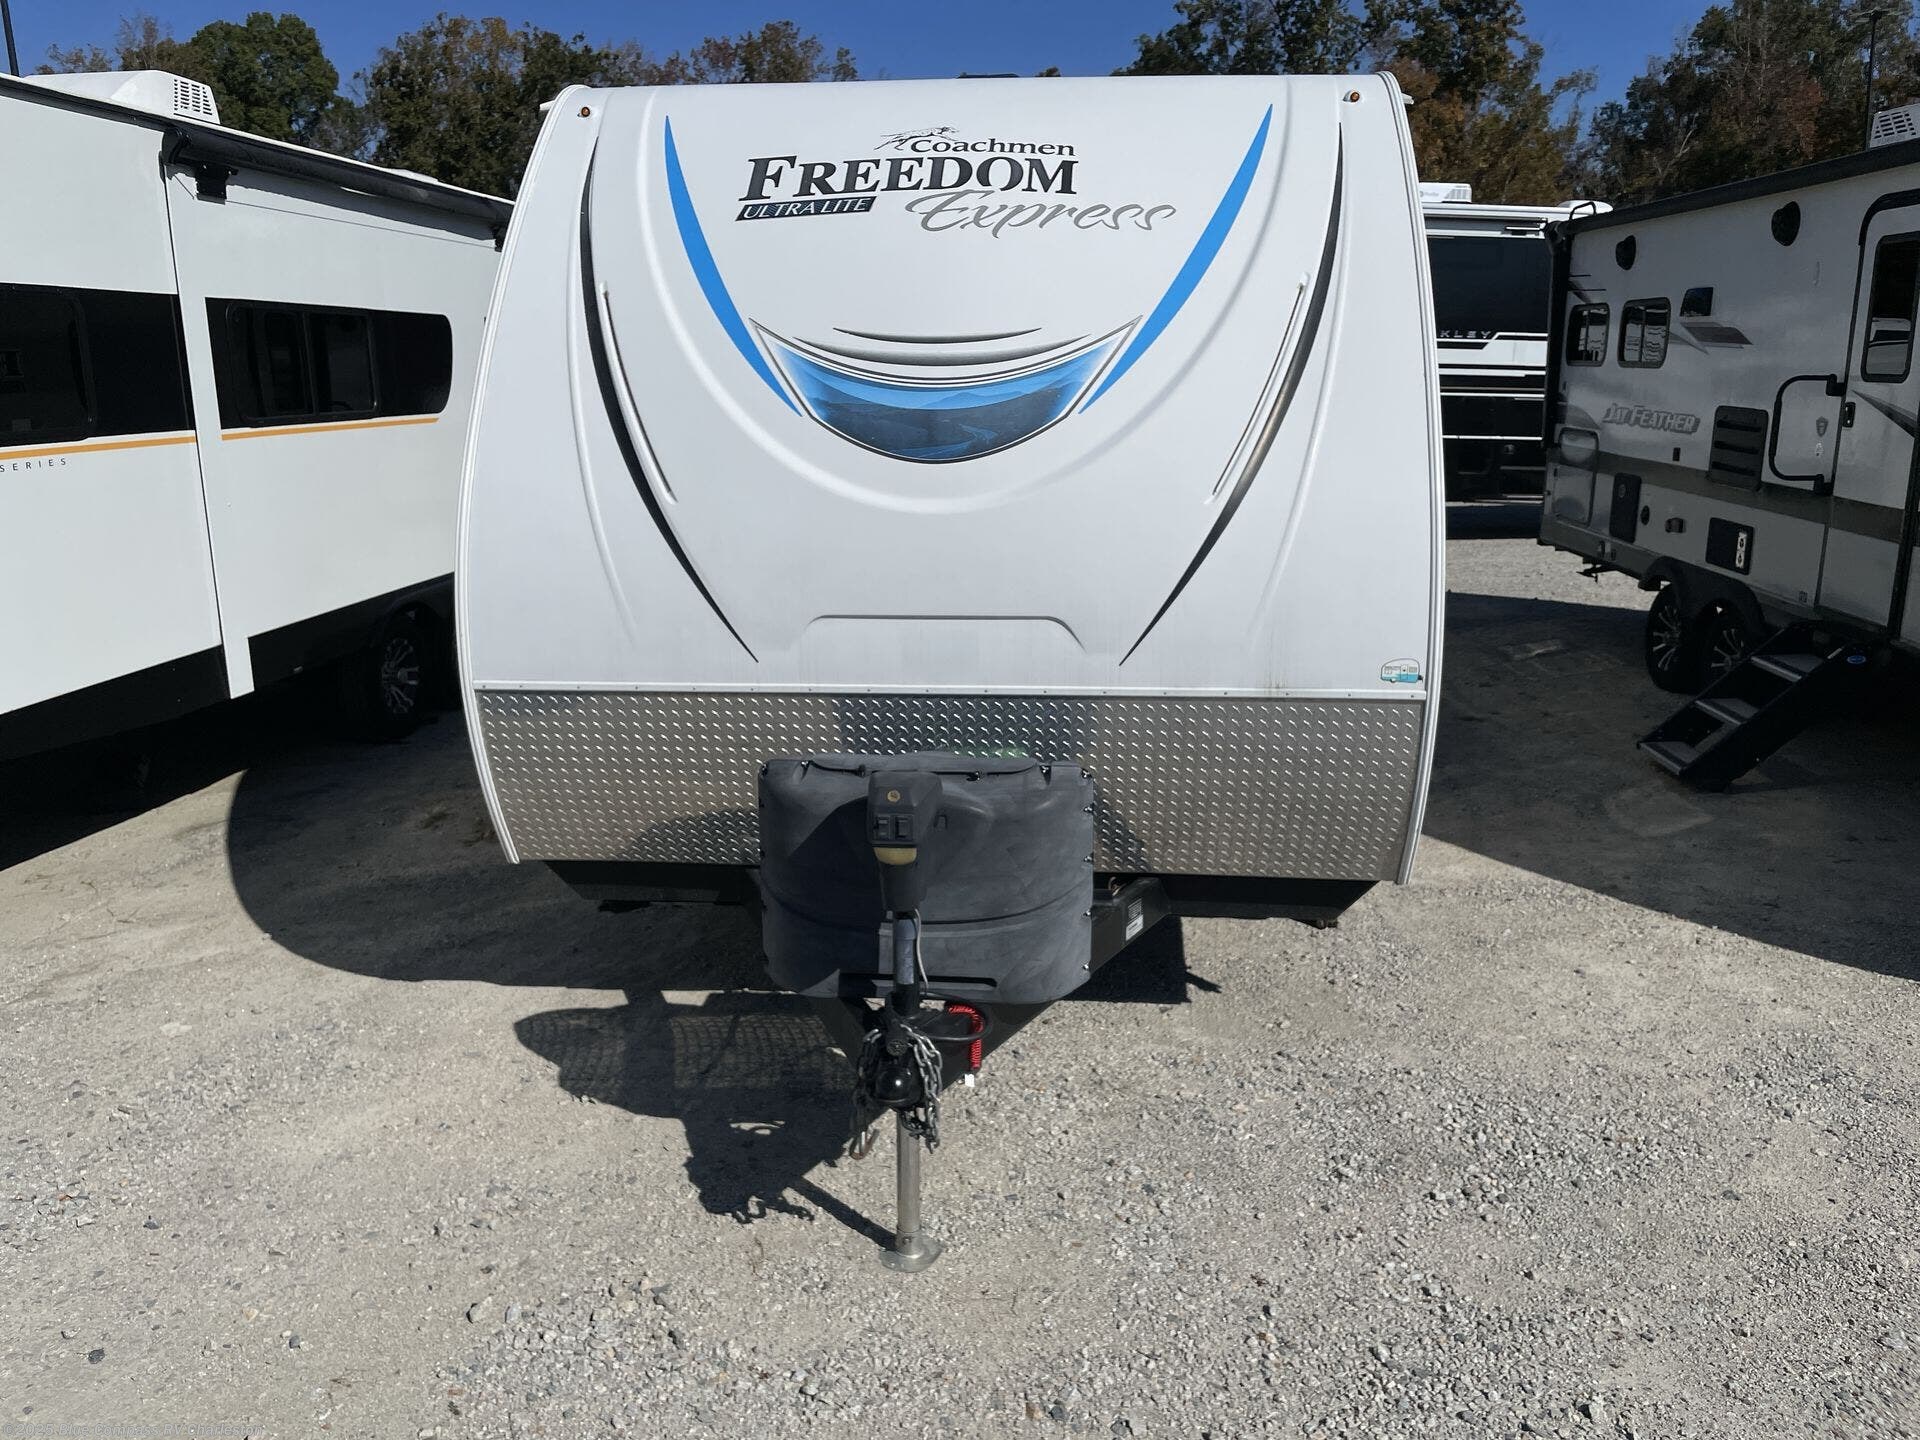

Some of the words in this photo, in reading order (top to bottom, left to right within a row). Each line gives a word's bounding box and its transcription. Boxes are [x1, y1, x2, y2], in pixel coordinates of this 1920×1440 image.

[910, 138, 1075, 157] Coachmen
[738, 155, 1079, 201] FREEDOM
[743, 201, 815, 220] ULTRA
[820, 198, 869, 214] LITE
[904, 189, 1177, 239] Express
[1629, 405, 1701, 434] FEATHER
[0, 457, 67, 473] SERIES
